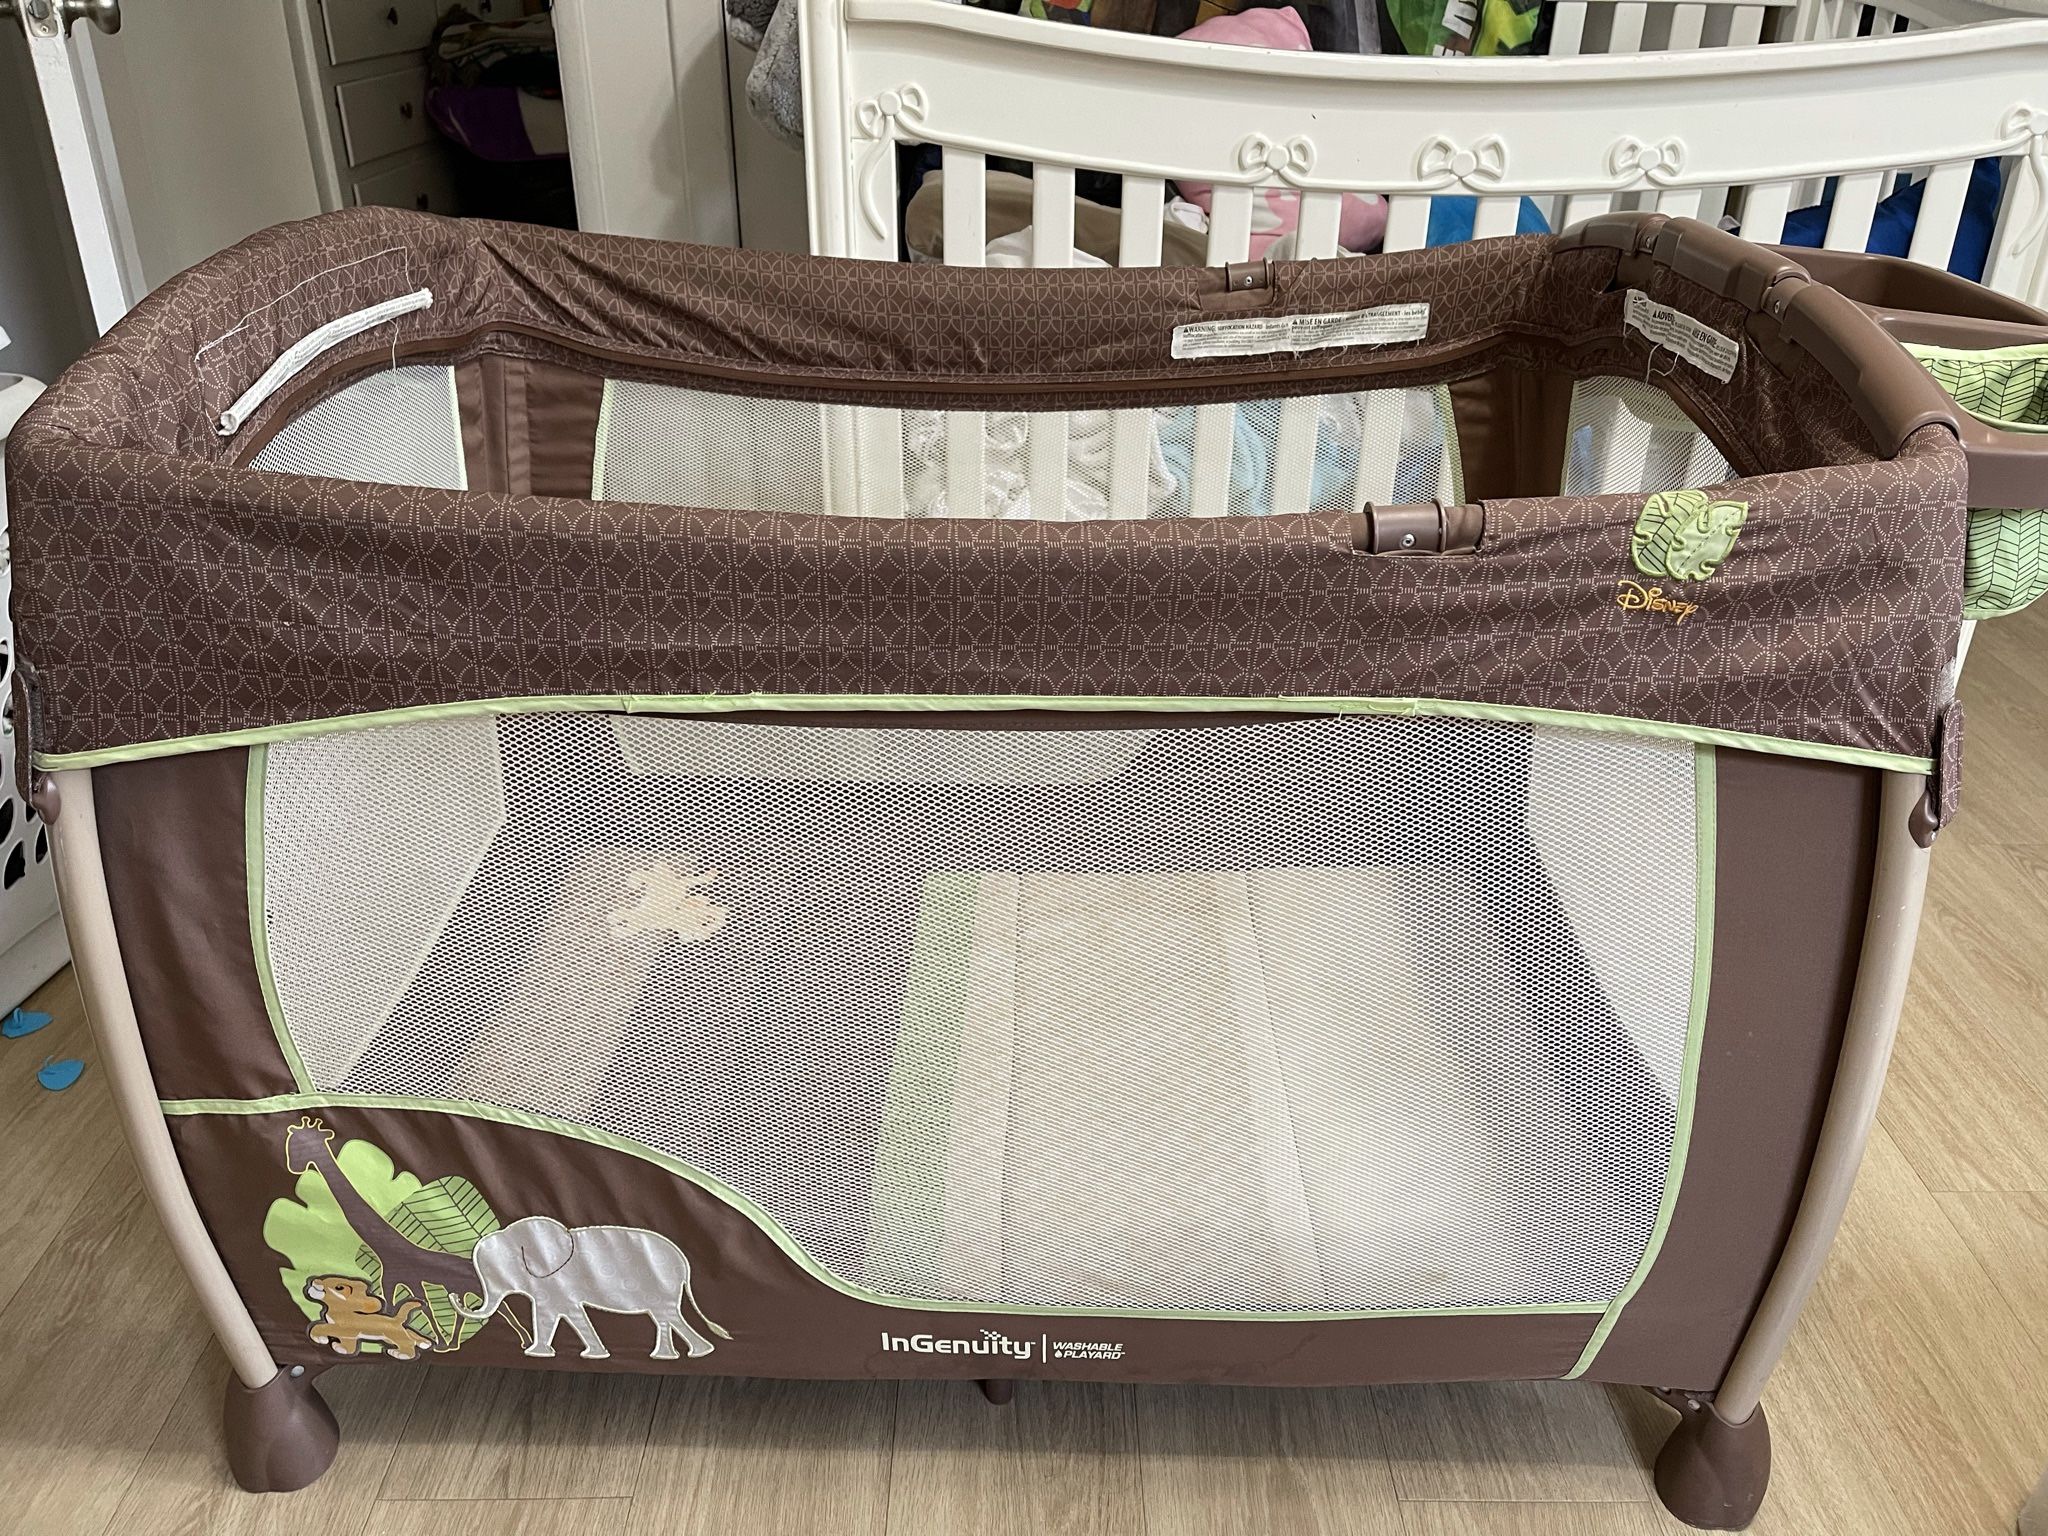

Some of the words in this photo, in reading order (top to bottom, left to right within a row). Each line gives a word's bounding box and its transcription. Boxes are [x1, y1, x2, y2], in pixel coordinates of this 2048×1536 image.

[1616, 579, 1699, 626] Disney
[1053, 1341, 1124, 1352] WASHABLE
[1063, 1350, 1122, 1361] PLAYARD
